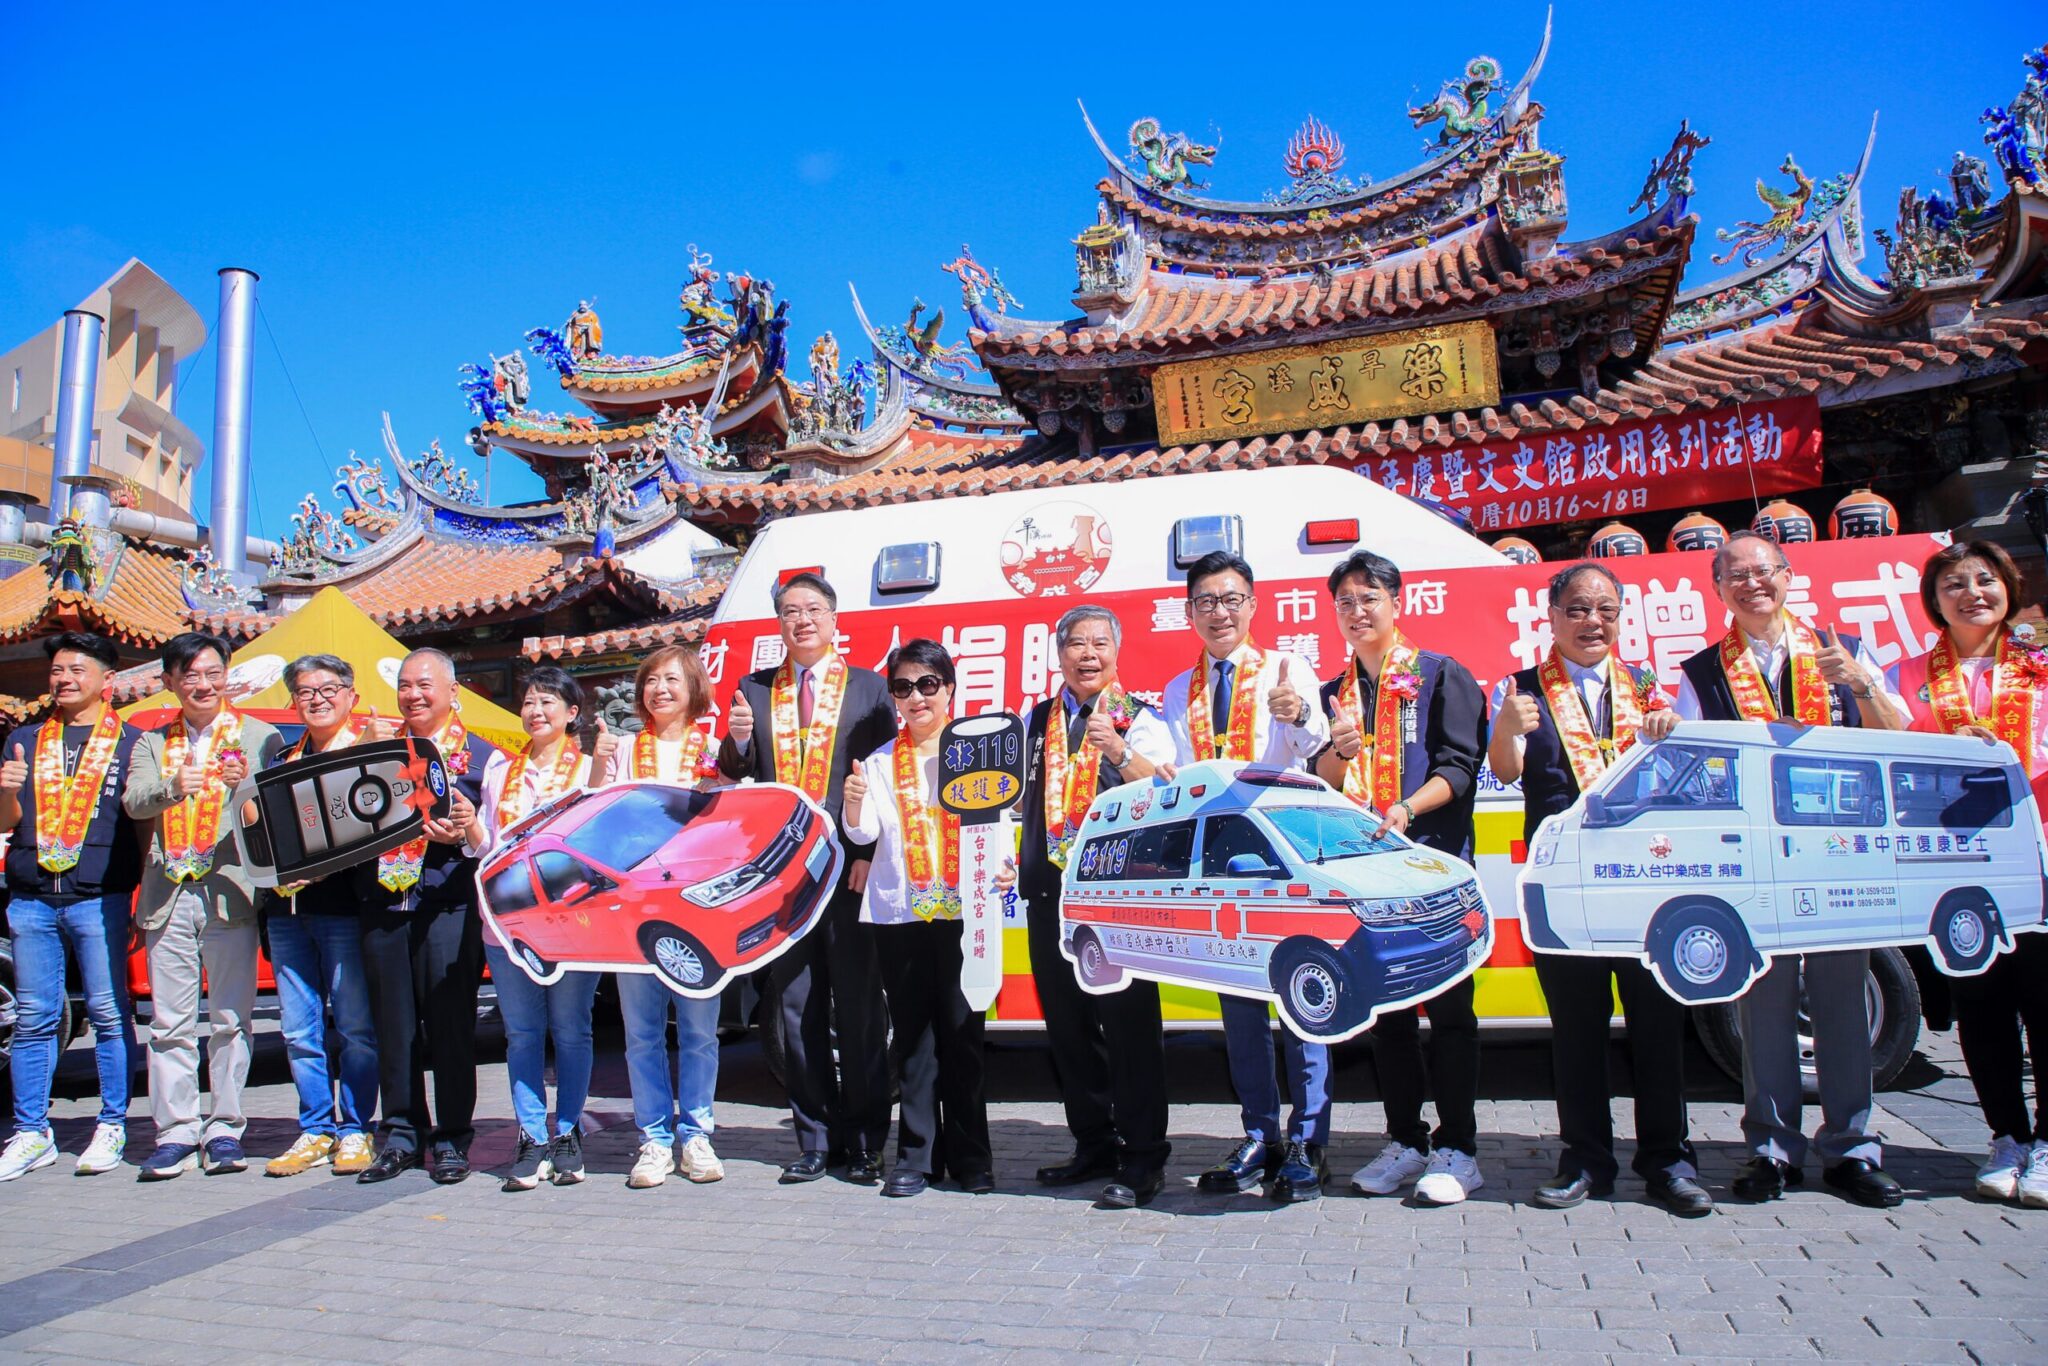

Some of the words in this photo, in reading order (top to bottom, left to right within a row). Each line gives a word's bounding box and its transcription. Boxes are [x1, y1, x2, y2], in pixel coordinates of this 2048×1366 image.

[977, 732, 1019, 769] 119
[431, 769, 444, 791] Ford
[950, 775, 1012, 803] 救護車
[1099, 839, 1129, 876] 119
[1853, 833, 1989, 854] 臺中市復康巴士
[973, 835, 987, 919] 台中樂成宮
[1594, 863, 1713, 879] 財團法人台中樂成宮
[1718, 864, 1743, 878] 捐贈
[973, 928, 986, 959] 捐贈
